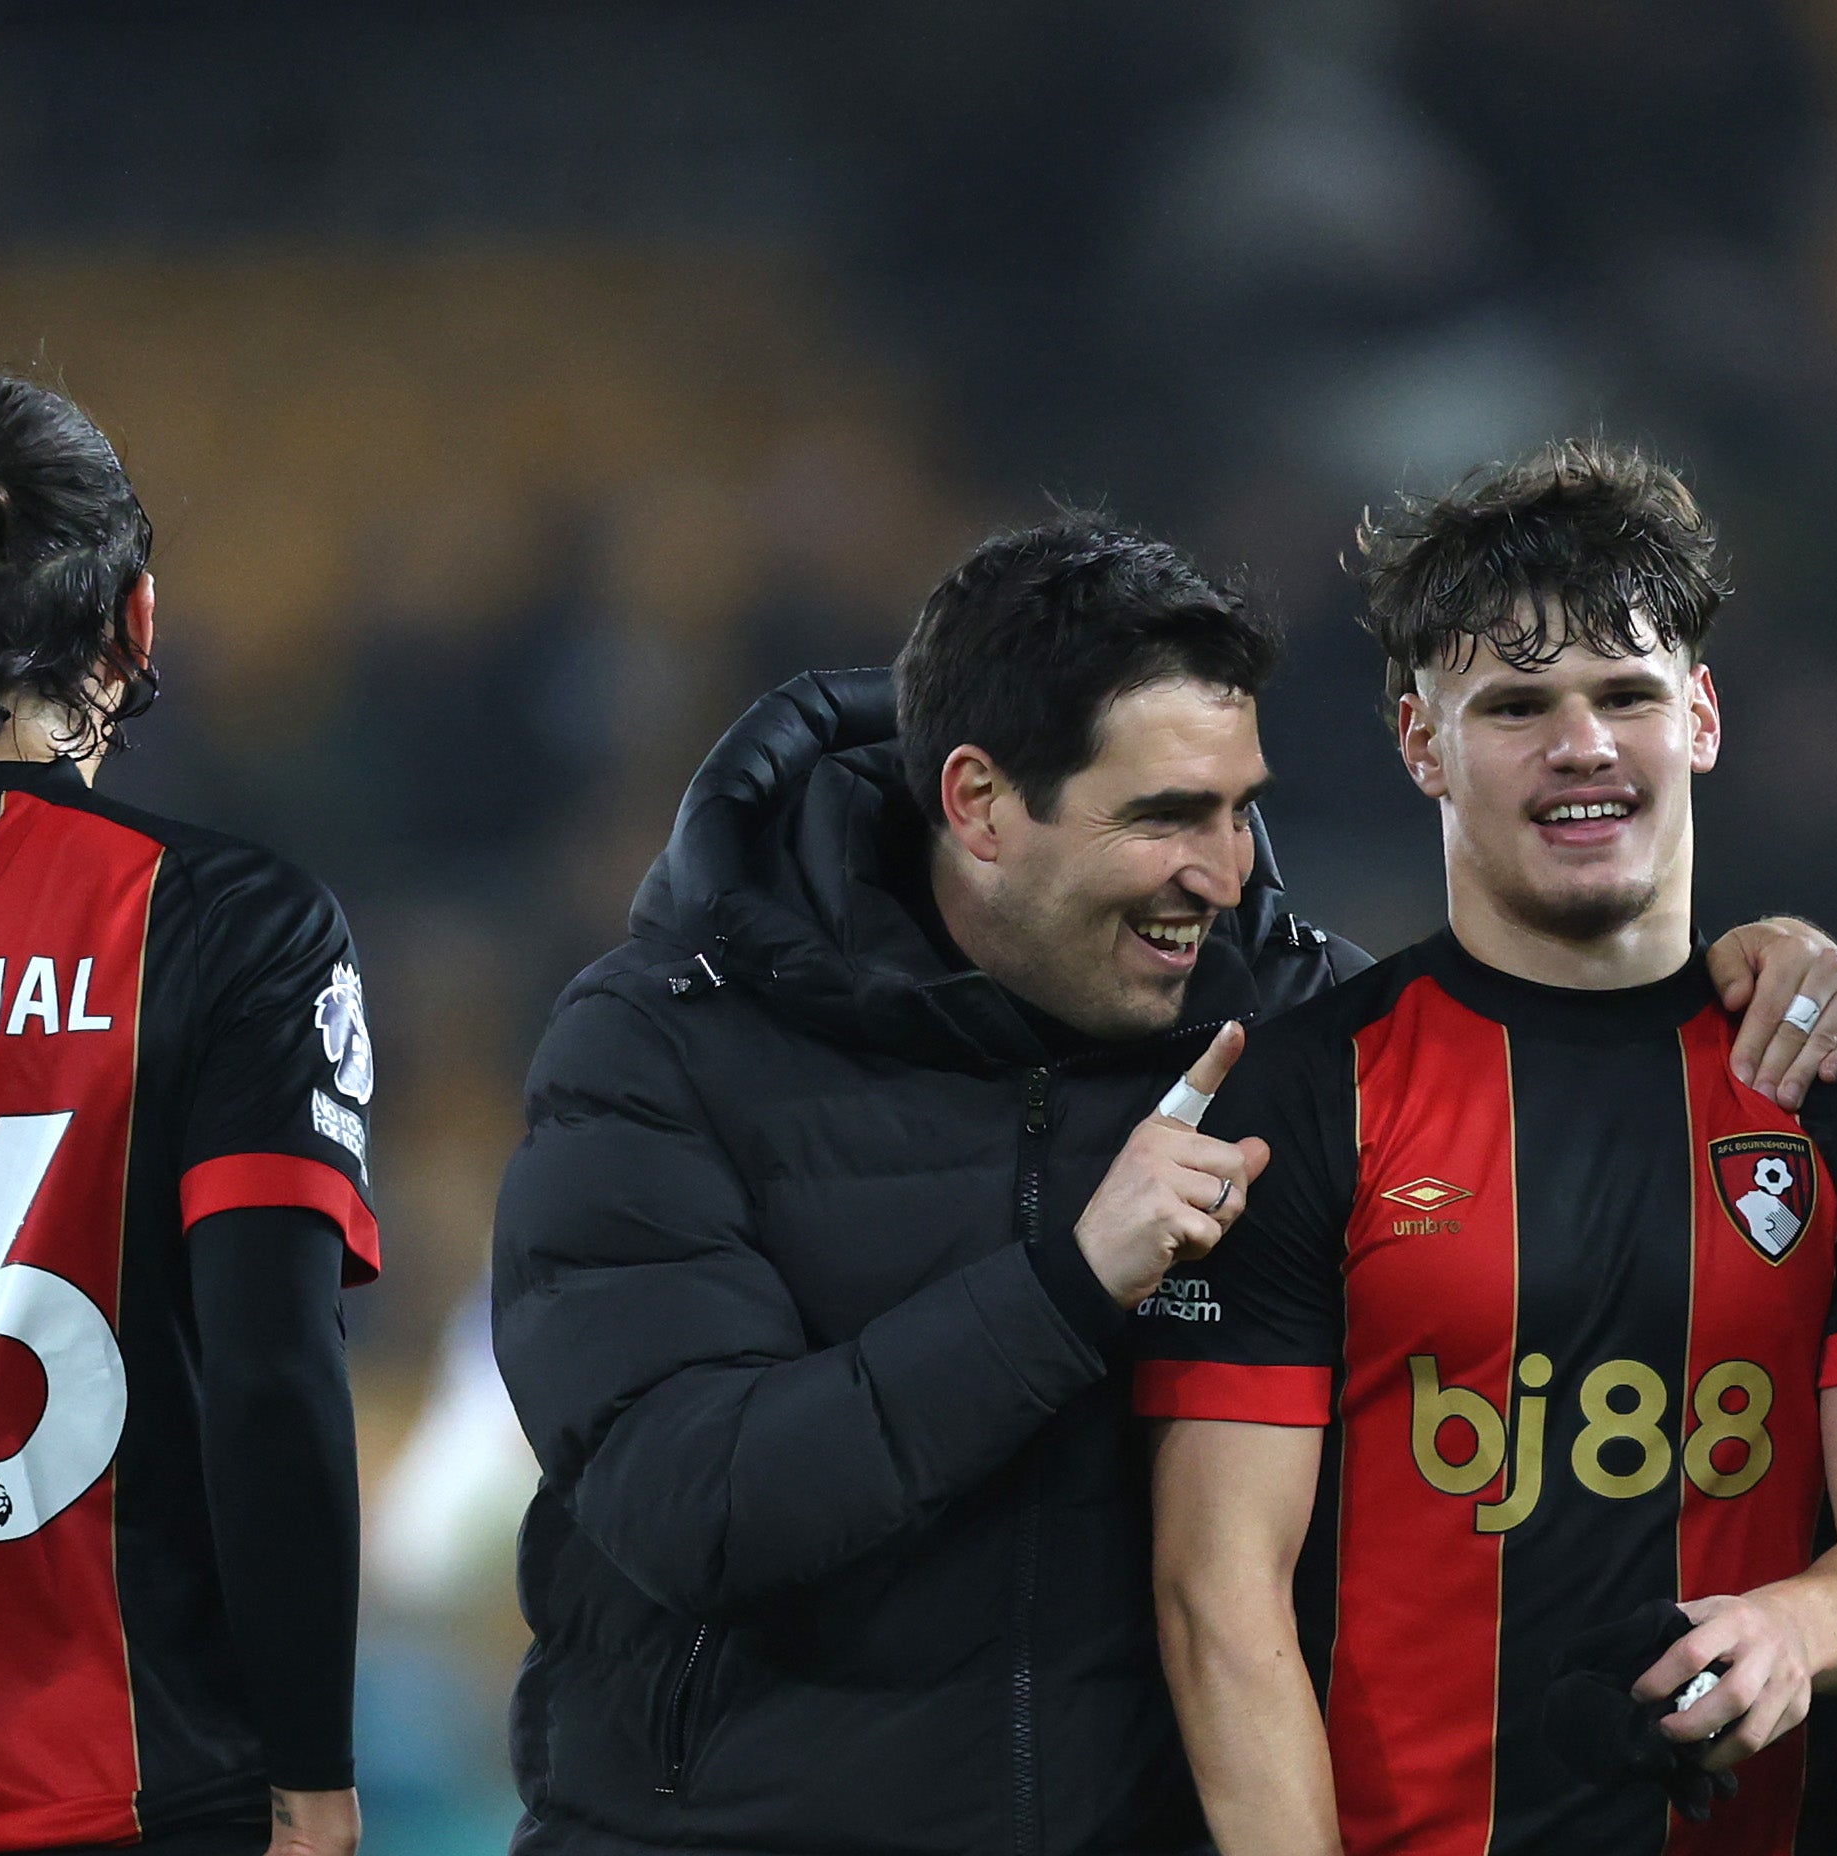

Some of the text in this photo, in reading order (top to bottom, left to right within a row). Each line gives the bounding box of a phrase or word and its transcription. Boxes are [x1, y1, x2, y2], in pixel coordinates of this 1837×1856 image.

[1393, 1216, 1461, 1236] umbro
[1158, 1278, 1210, 1299] oom
[1408, 1352, 1774, 1534] bj88
